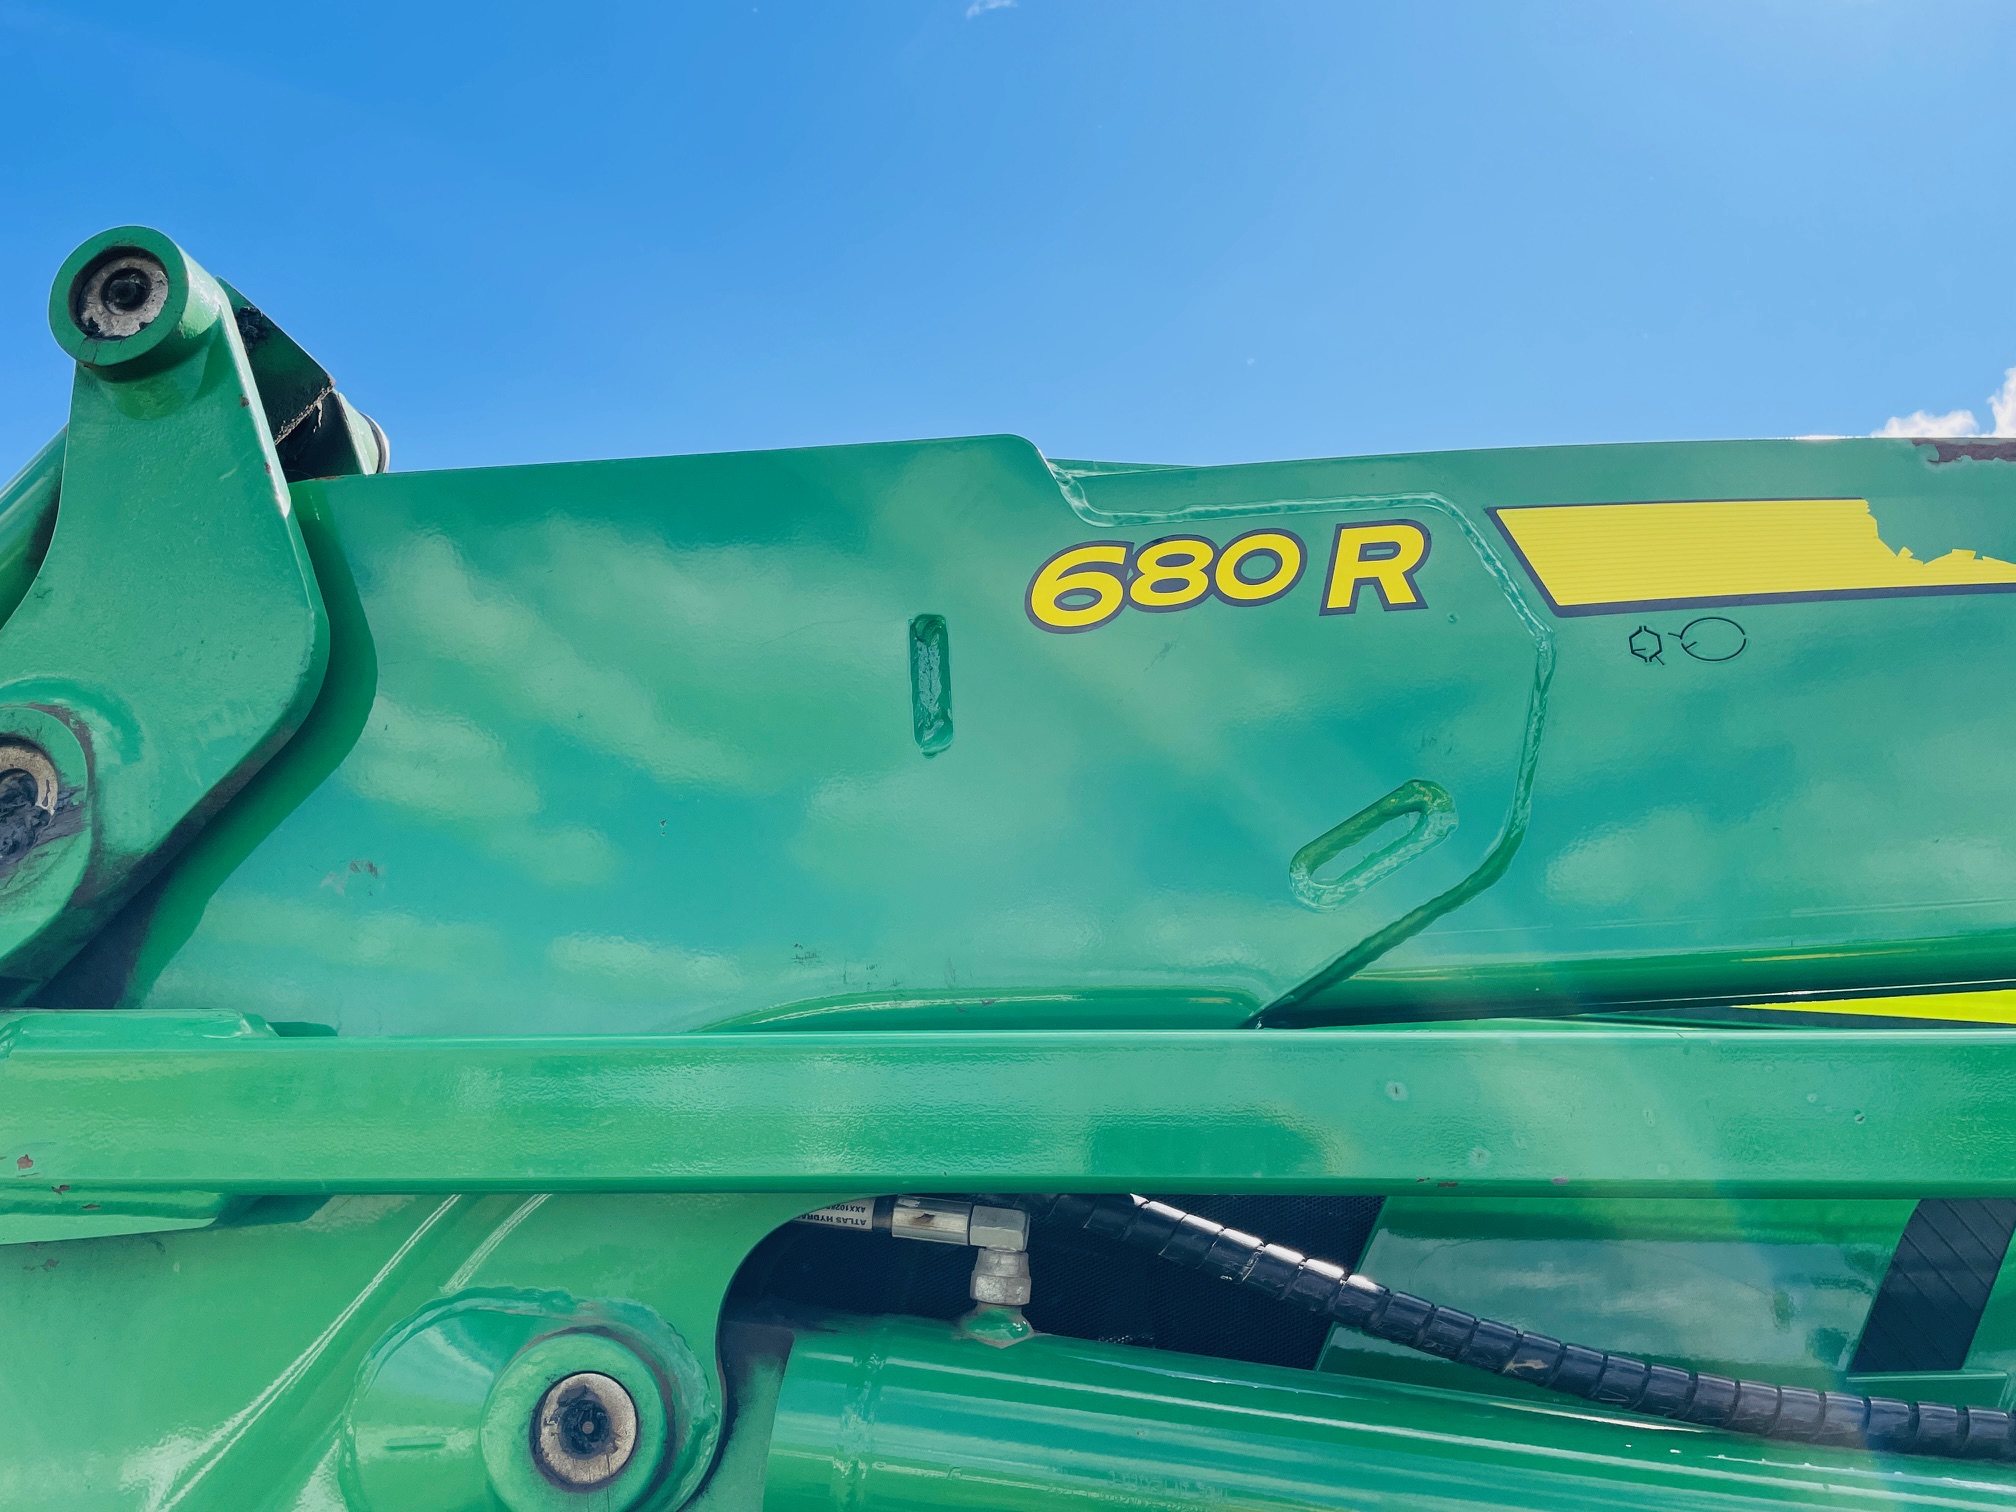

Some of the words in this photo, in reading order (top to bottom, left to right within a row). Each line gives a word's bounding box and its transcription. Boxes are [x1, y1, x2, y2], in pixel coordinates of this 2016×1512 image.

[1025, 528, 1308, 634] 680
[1319, 519, 1431, 616] R
[798, 1213, 834, 1223] HYDRA
[836, 1216, 867, 1226] ATLAS
